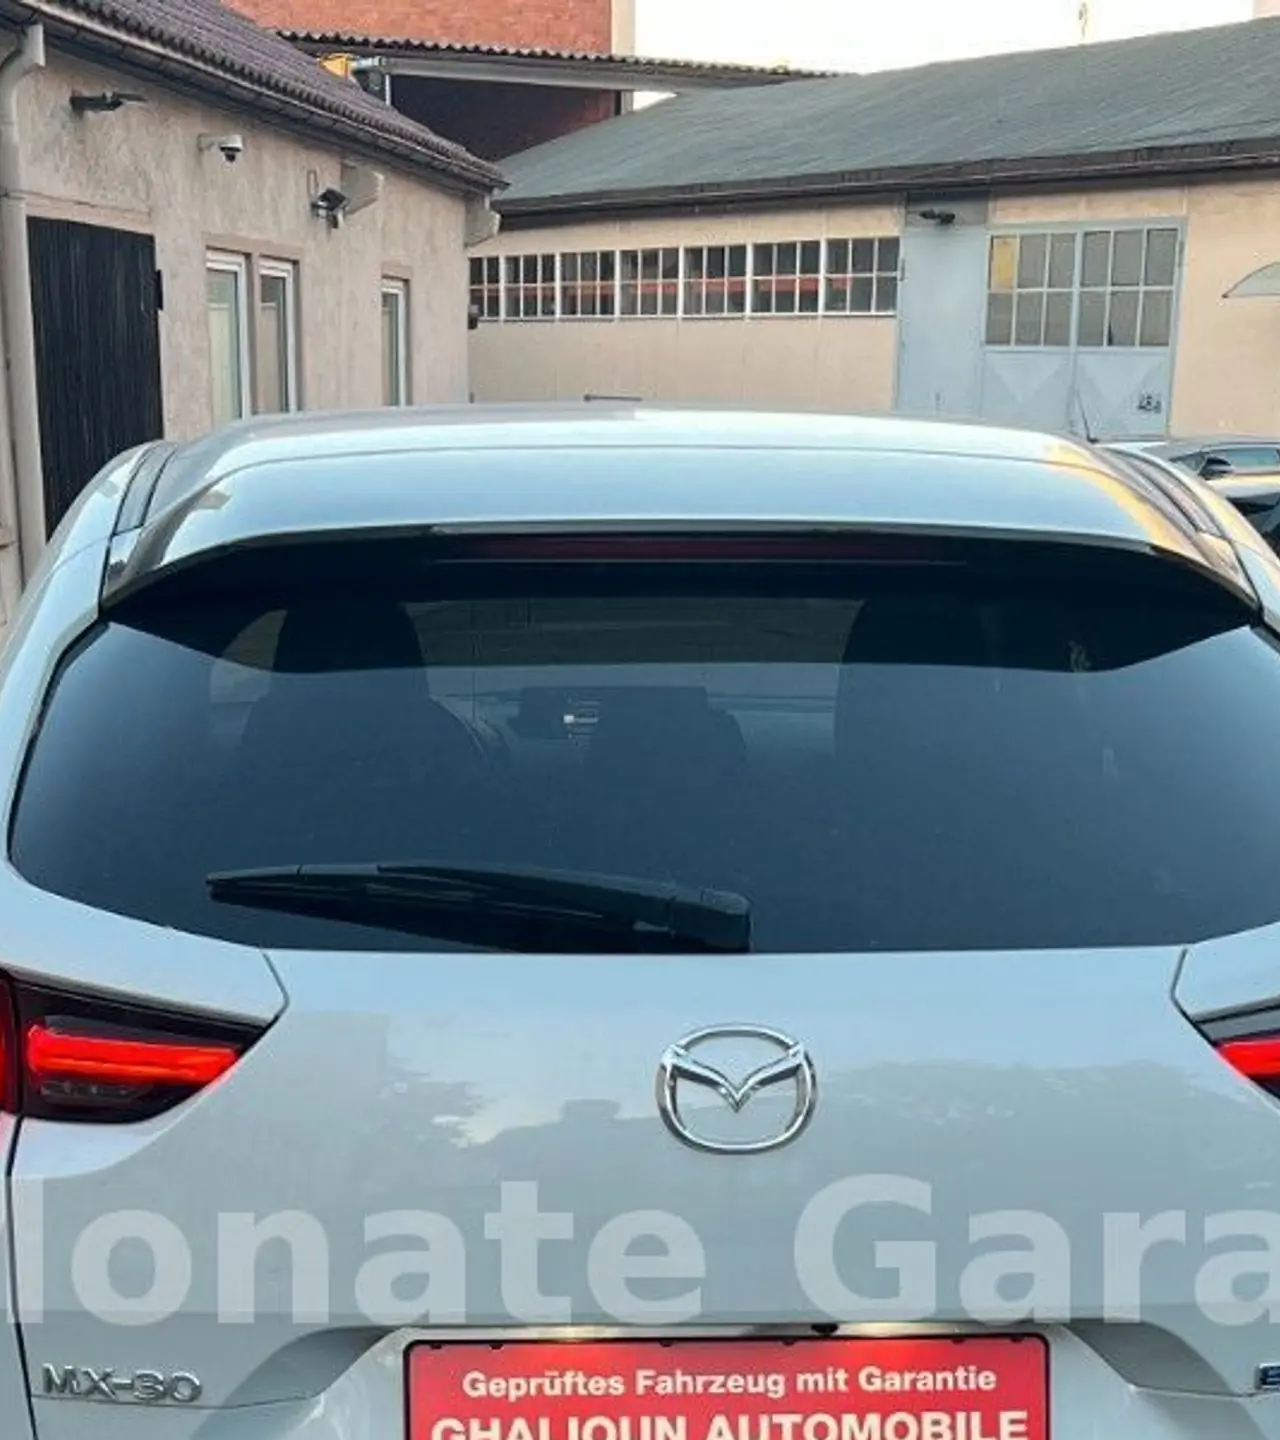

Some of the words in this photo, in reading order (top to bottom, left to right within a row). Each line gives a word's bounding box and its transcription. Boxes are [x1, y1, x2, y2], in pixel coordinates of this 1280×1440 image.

[462, 1369, 625, 1401] Geprüftes
[635, 1369, 786, 1399] Fahrzeug
[795, 1366, 848, 1393] mit
[858, 1365, 998, 1392] Garantie
